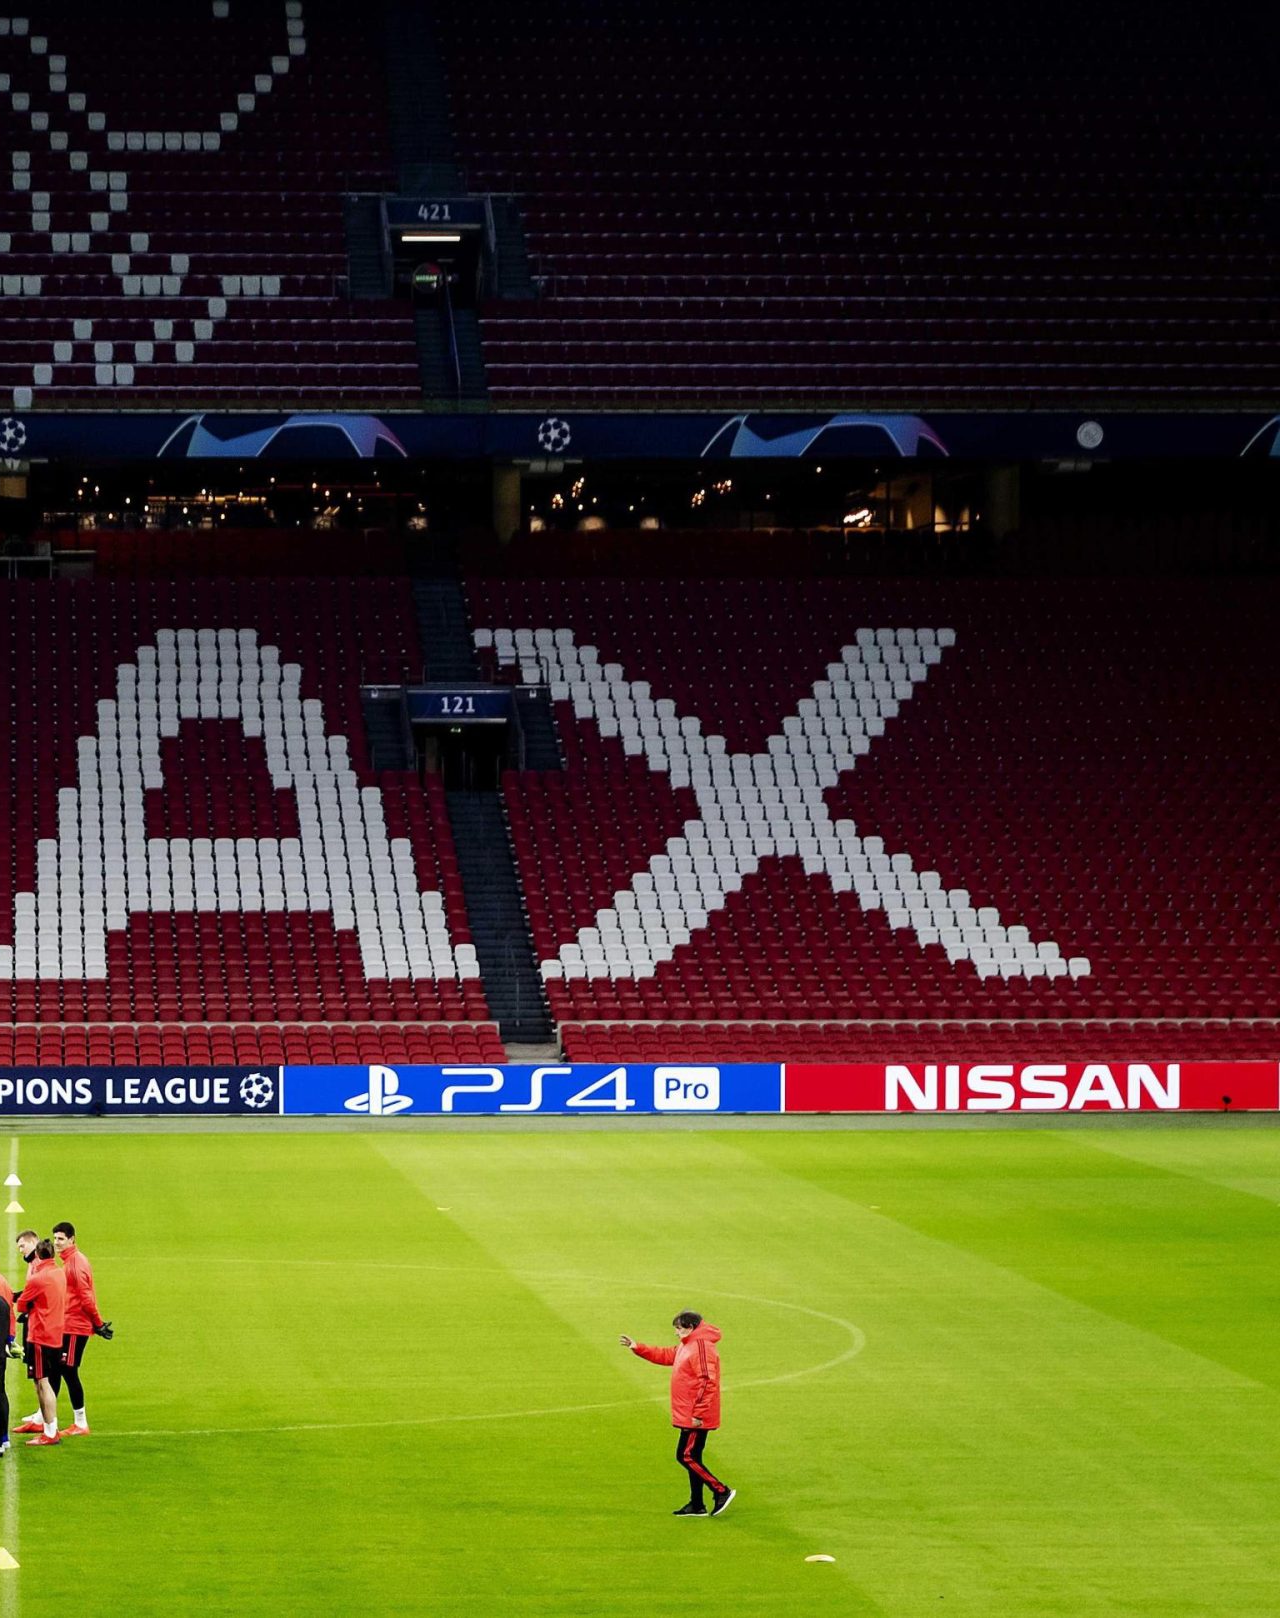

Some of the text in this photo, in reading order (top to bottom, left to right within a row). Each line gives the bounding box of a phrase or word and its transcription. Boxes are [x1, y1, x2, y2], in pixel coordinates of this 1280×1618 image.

[417, 203, 452, 220] 421
[440, 696, 476, 713] 121
[105, 1078, 230, 1104] LEAGUE
[441, 1066, 710, 1112] PS4 Pro
[885, 1063, 1180, 1111] NISSAN
